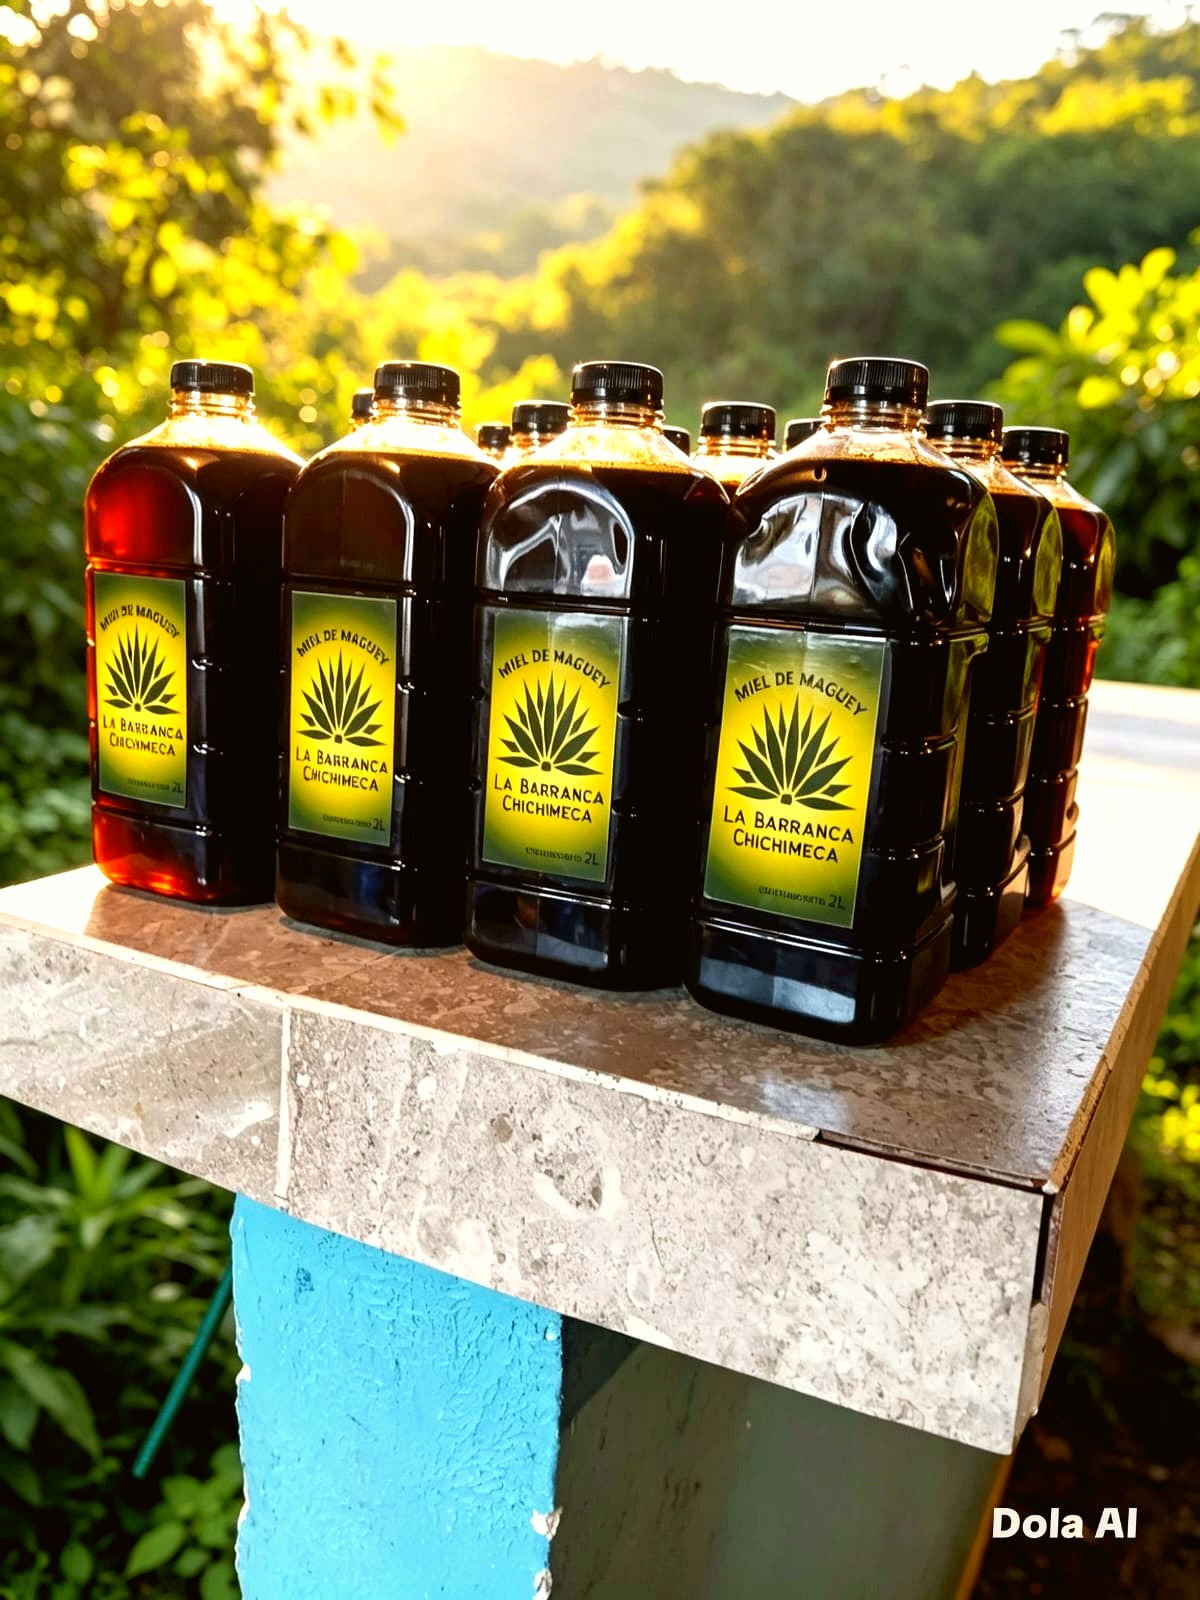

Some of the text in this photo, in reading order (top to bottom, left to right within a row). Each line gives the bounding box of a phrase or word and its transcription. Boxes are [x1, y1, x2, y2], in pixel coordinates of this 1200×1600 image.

[323, 628, 338, 642] DE
[340, 629, 390, 666] MAGUEY
[498, 648, 611, 689] MIEL DE MAGUEY
[734, 671, 869, 717] MIEL DE MAGUEY
[103, 714, 116, 729] LA
[295, 745, 388, 774] LA BARRANCA
[303, 765, 379, 792] CHICHIMECA
[494, 772, 605, 806] LA BARRANCA
[502, 794, 593, 824] CHICHIMECA
[723, 804, 855, 845] LA BARRANCA
[584, 851, 600, 866] 2L
[733, 827, 839, 864] CHICHIMECA
[828, 893, 847, 910] 2L
